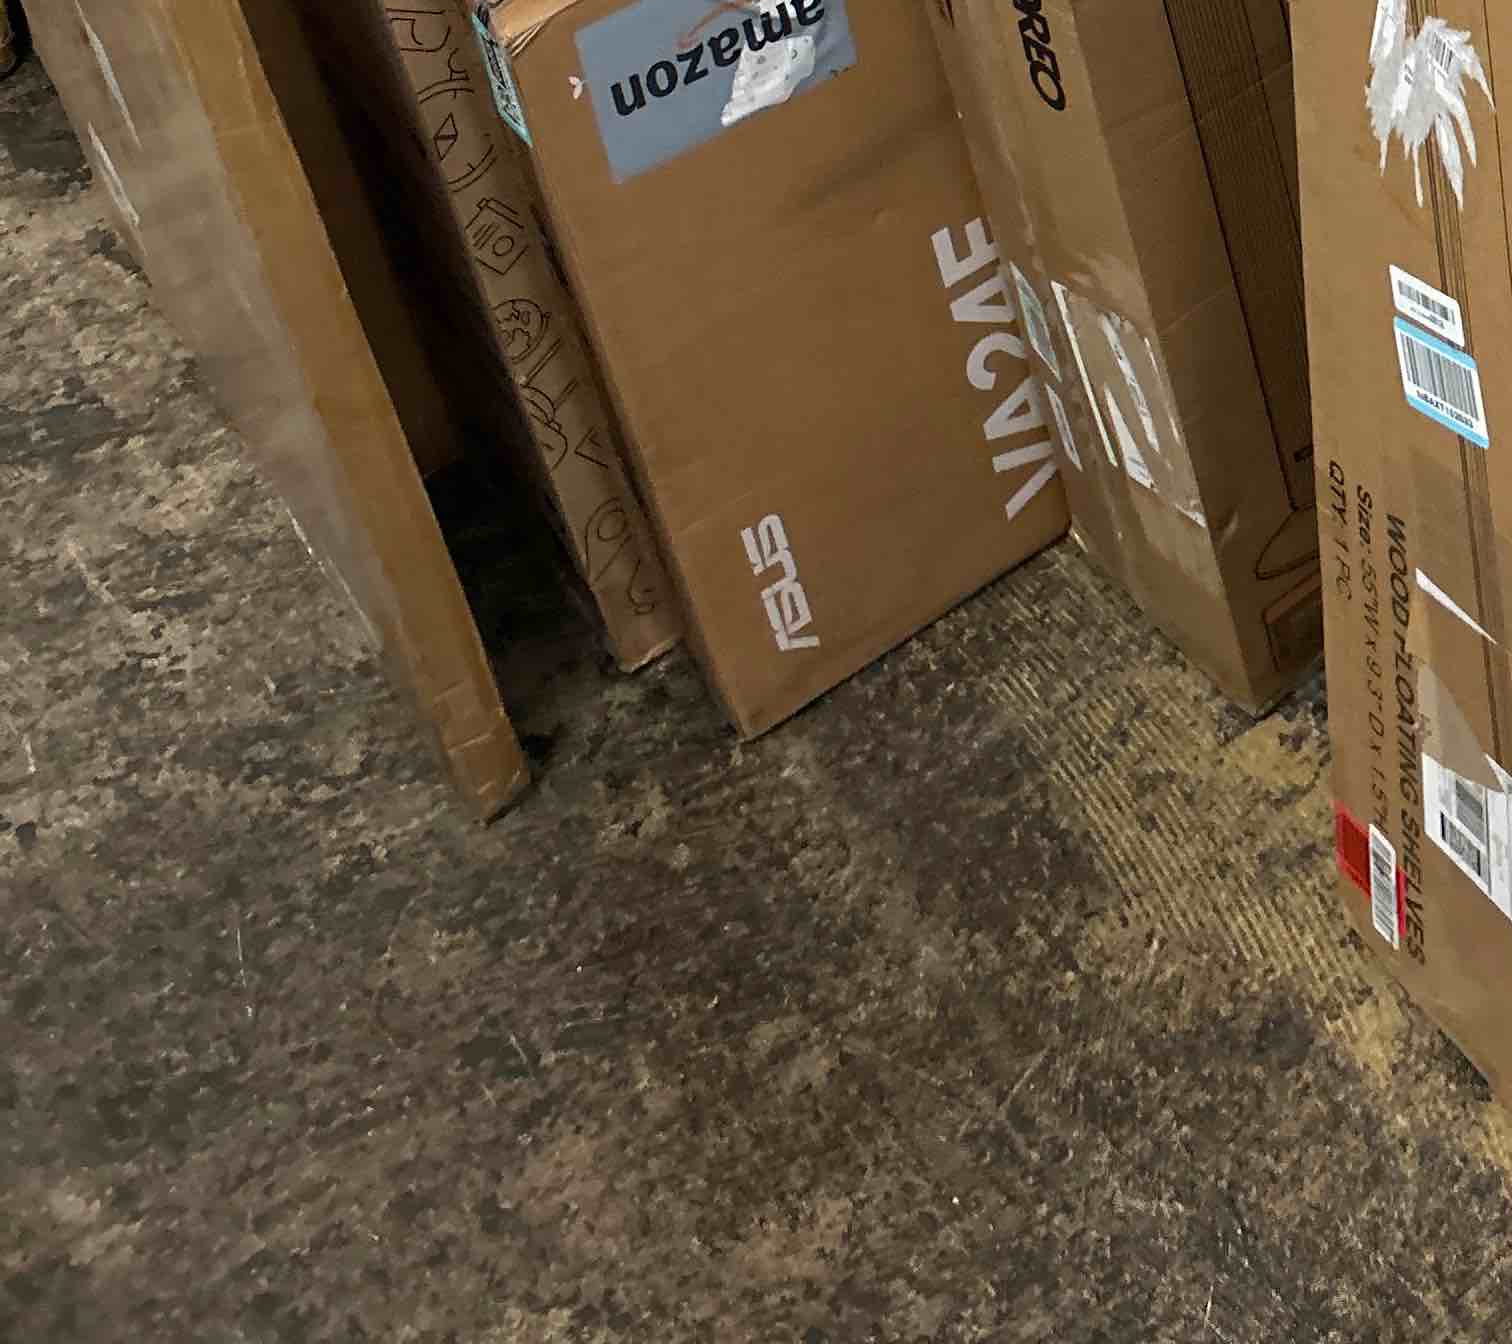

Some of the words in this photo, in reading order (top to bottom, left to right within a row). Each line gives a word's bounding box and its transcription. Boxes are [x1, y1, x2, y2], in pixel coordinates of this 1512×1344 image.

[1386, 512, 1410, 627] WOOD
[1392, 629, 1419, 806] FLOATING
[1402, 809, 1425, 966] SHELVES
